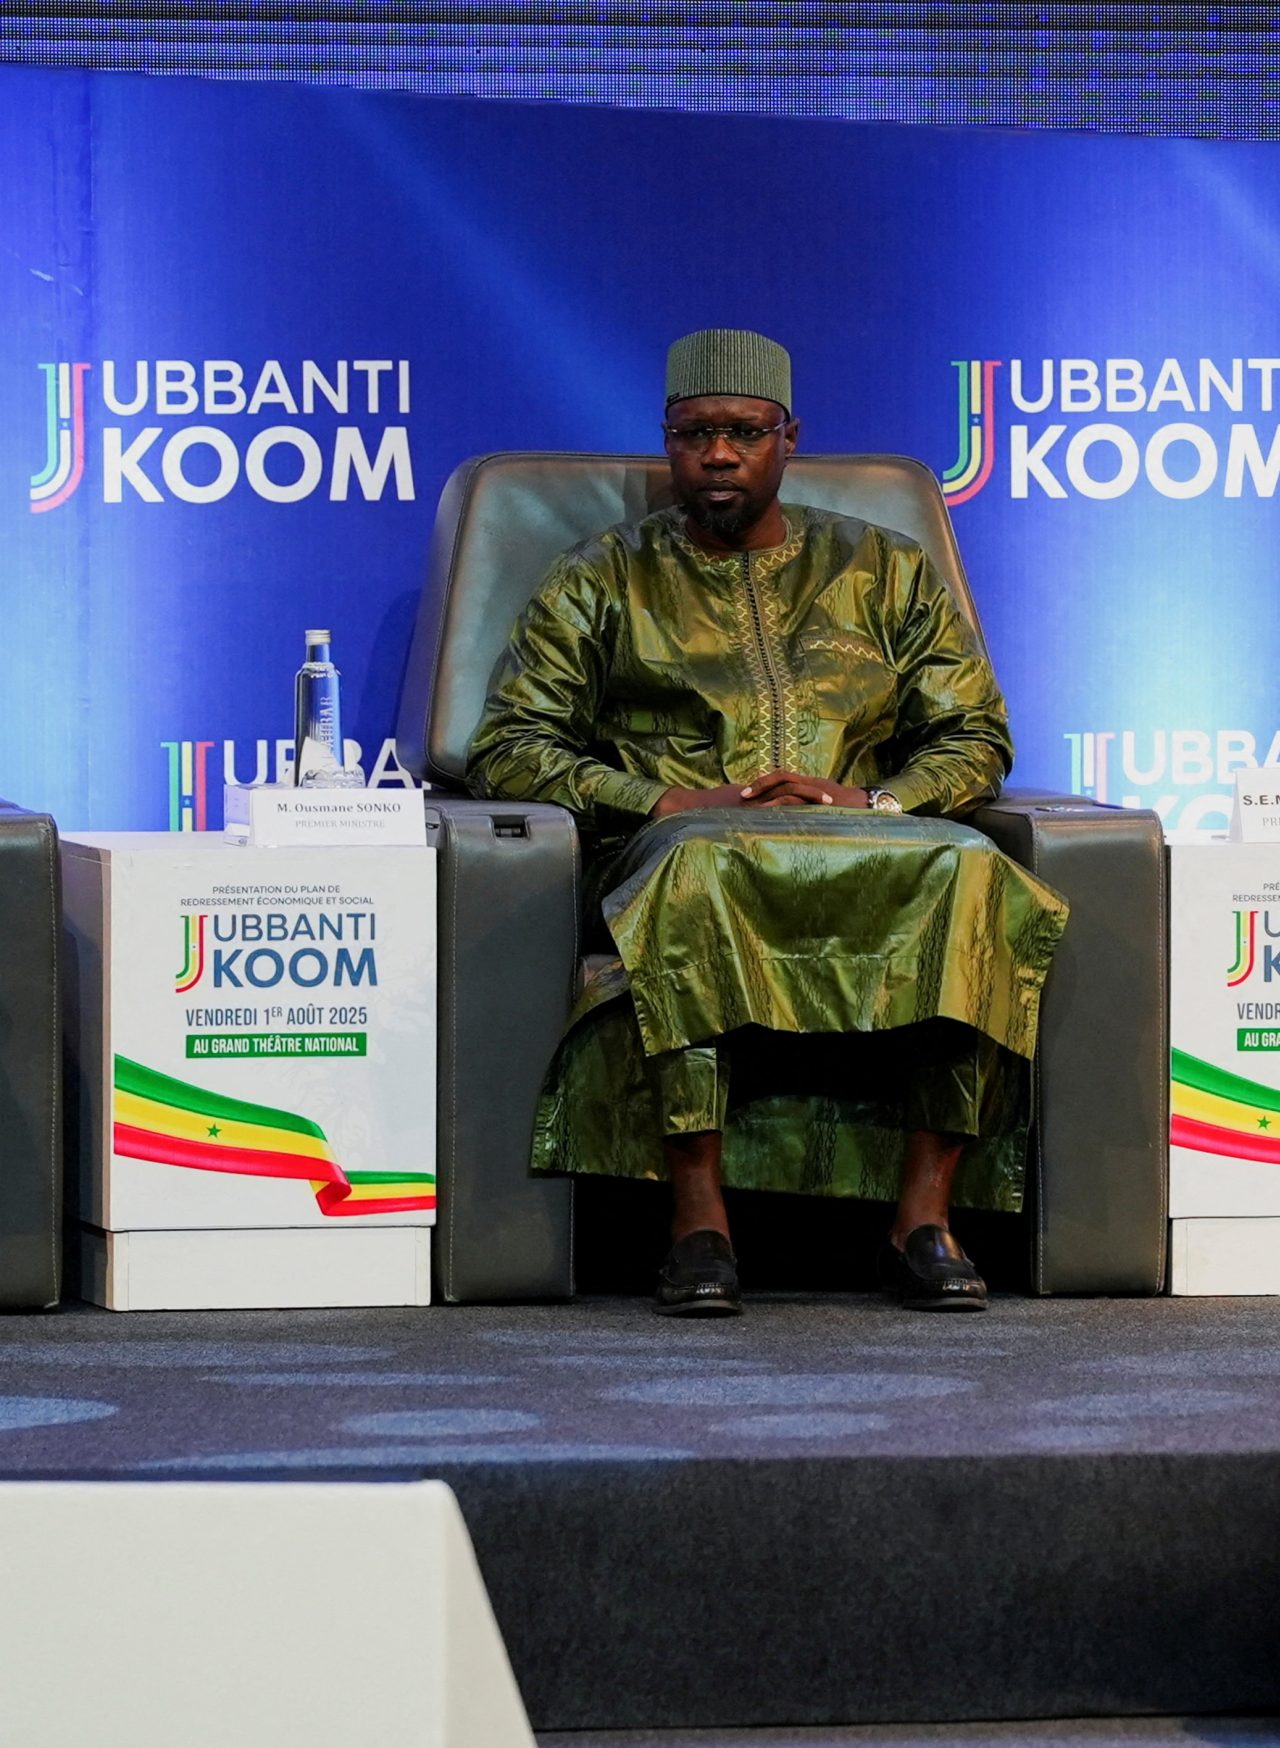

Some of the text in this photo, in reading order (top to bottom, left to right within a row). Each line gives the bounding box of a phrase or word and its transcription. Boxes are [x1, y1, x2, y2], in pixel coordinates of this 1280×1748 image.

[103, 425, 415, 503] KOOM
[277, 803, 401, 812] M. Ousmane SONKO
[296, 820, 385, 828] PREMIER MINISTRE
[212, 885, 340, 894] PRÉSENTATION DU PLAN DE
[180, 896, 374, 906] REDRESSEMENT ÉCONOMIQUE ET SOCIAL
[213, 948, 378, 988] KOOM
[186, 1008, 257, 1026] VENDREDI
[287, 1003, 324, 1025] AOÛT
[329, 1007, 367, 1025] 2025
[193, 1034, 359, 1054] AU GRAND THÉÂTRE NATIONAL
[1244, 1032, 1259, 1047] AU
